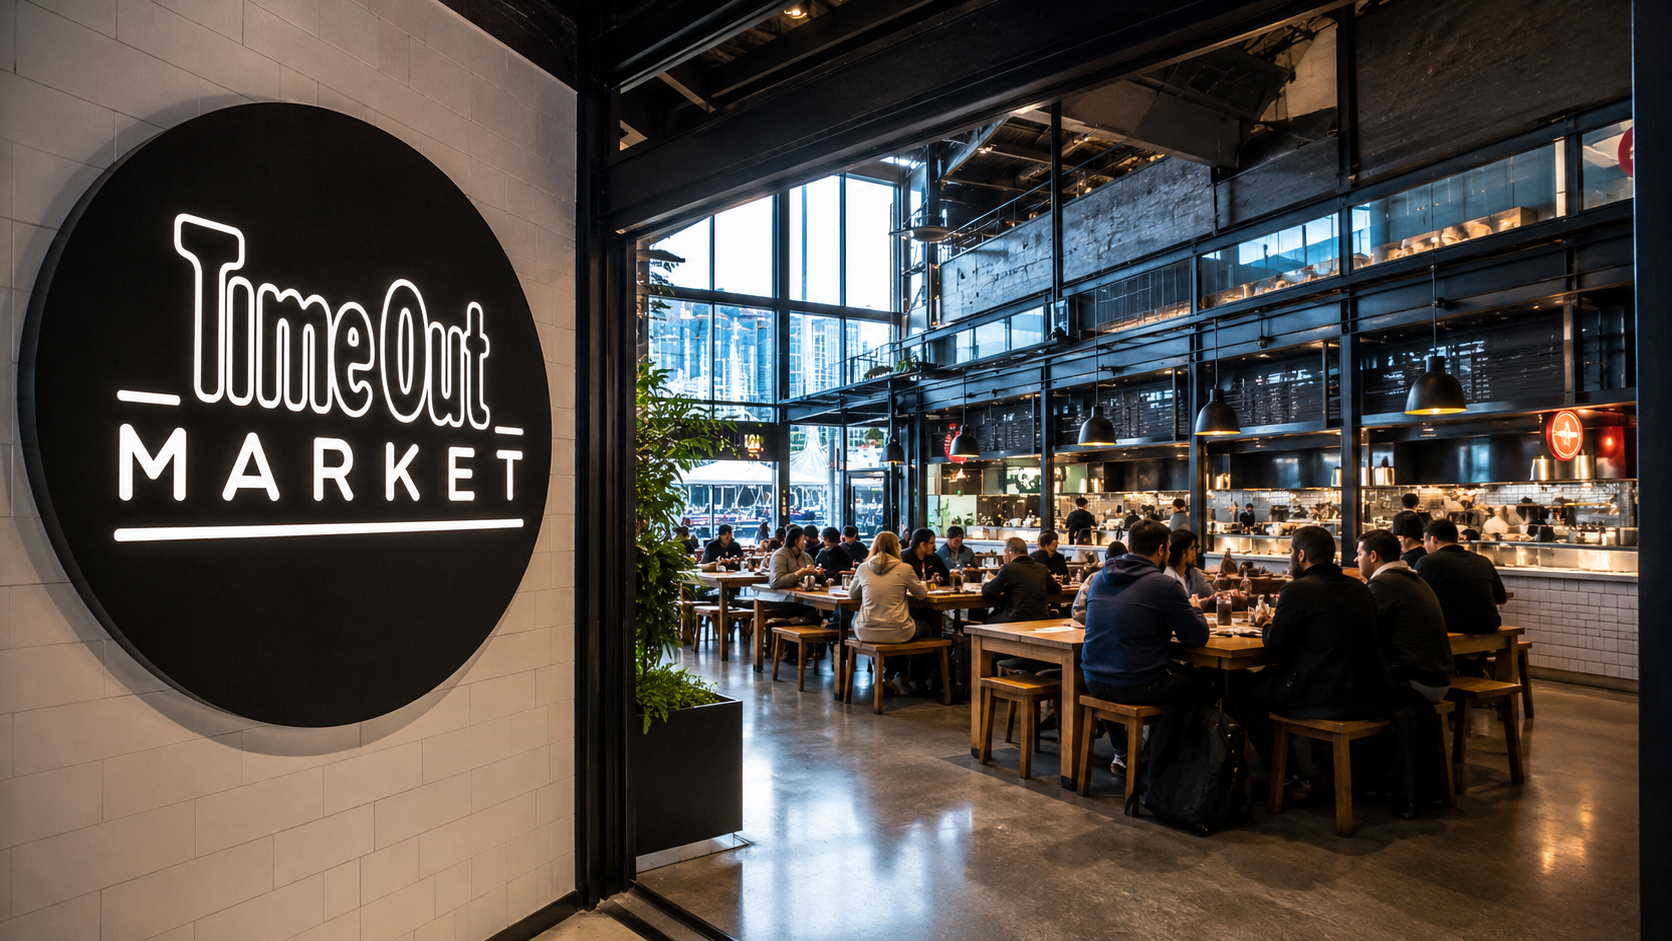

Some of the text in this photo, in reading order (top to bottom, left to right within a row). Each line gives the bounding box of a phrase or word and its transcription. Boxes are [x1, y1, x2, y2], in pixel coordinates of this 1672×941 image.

[173, 212, 491, 431] Time Out
[118, 423, 524, 502] MARKET
